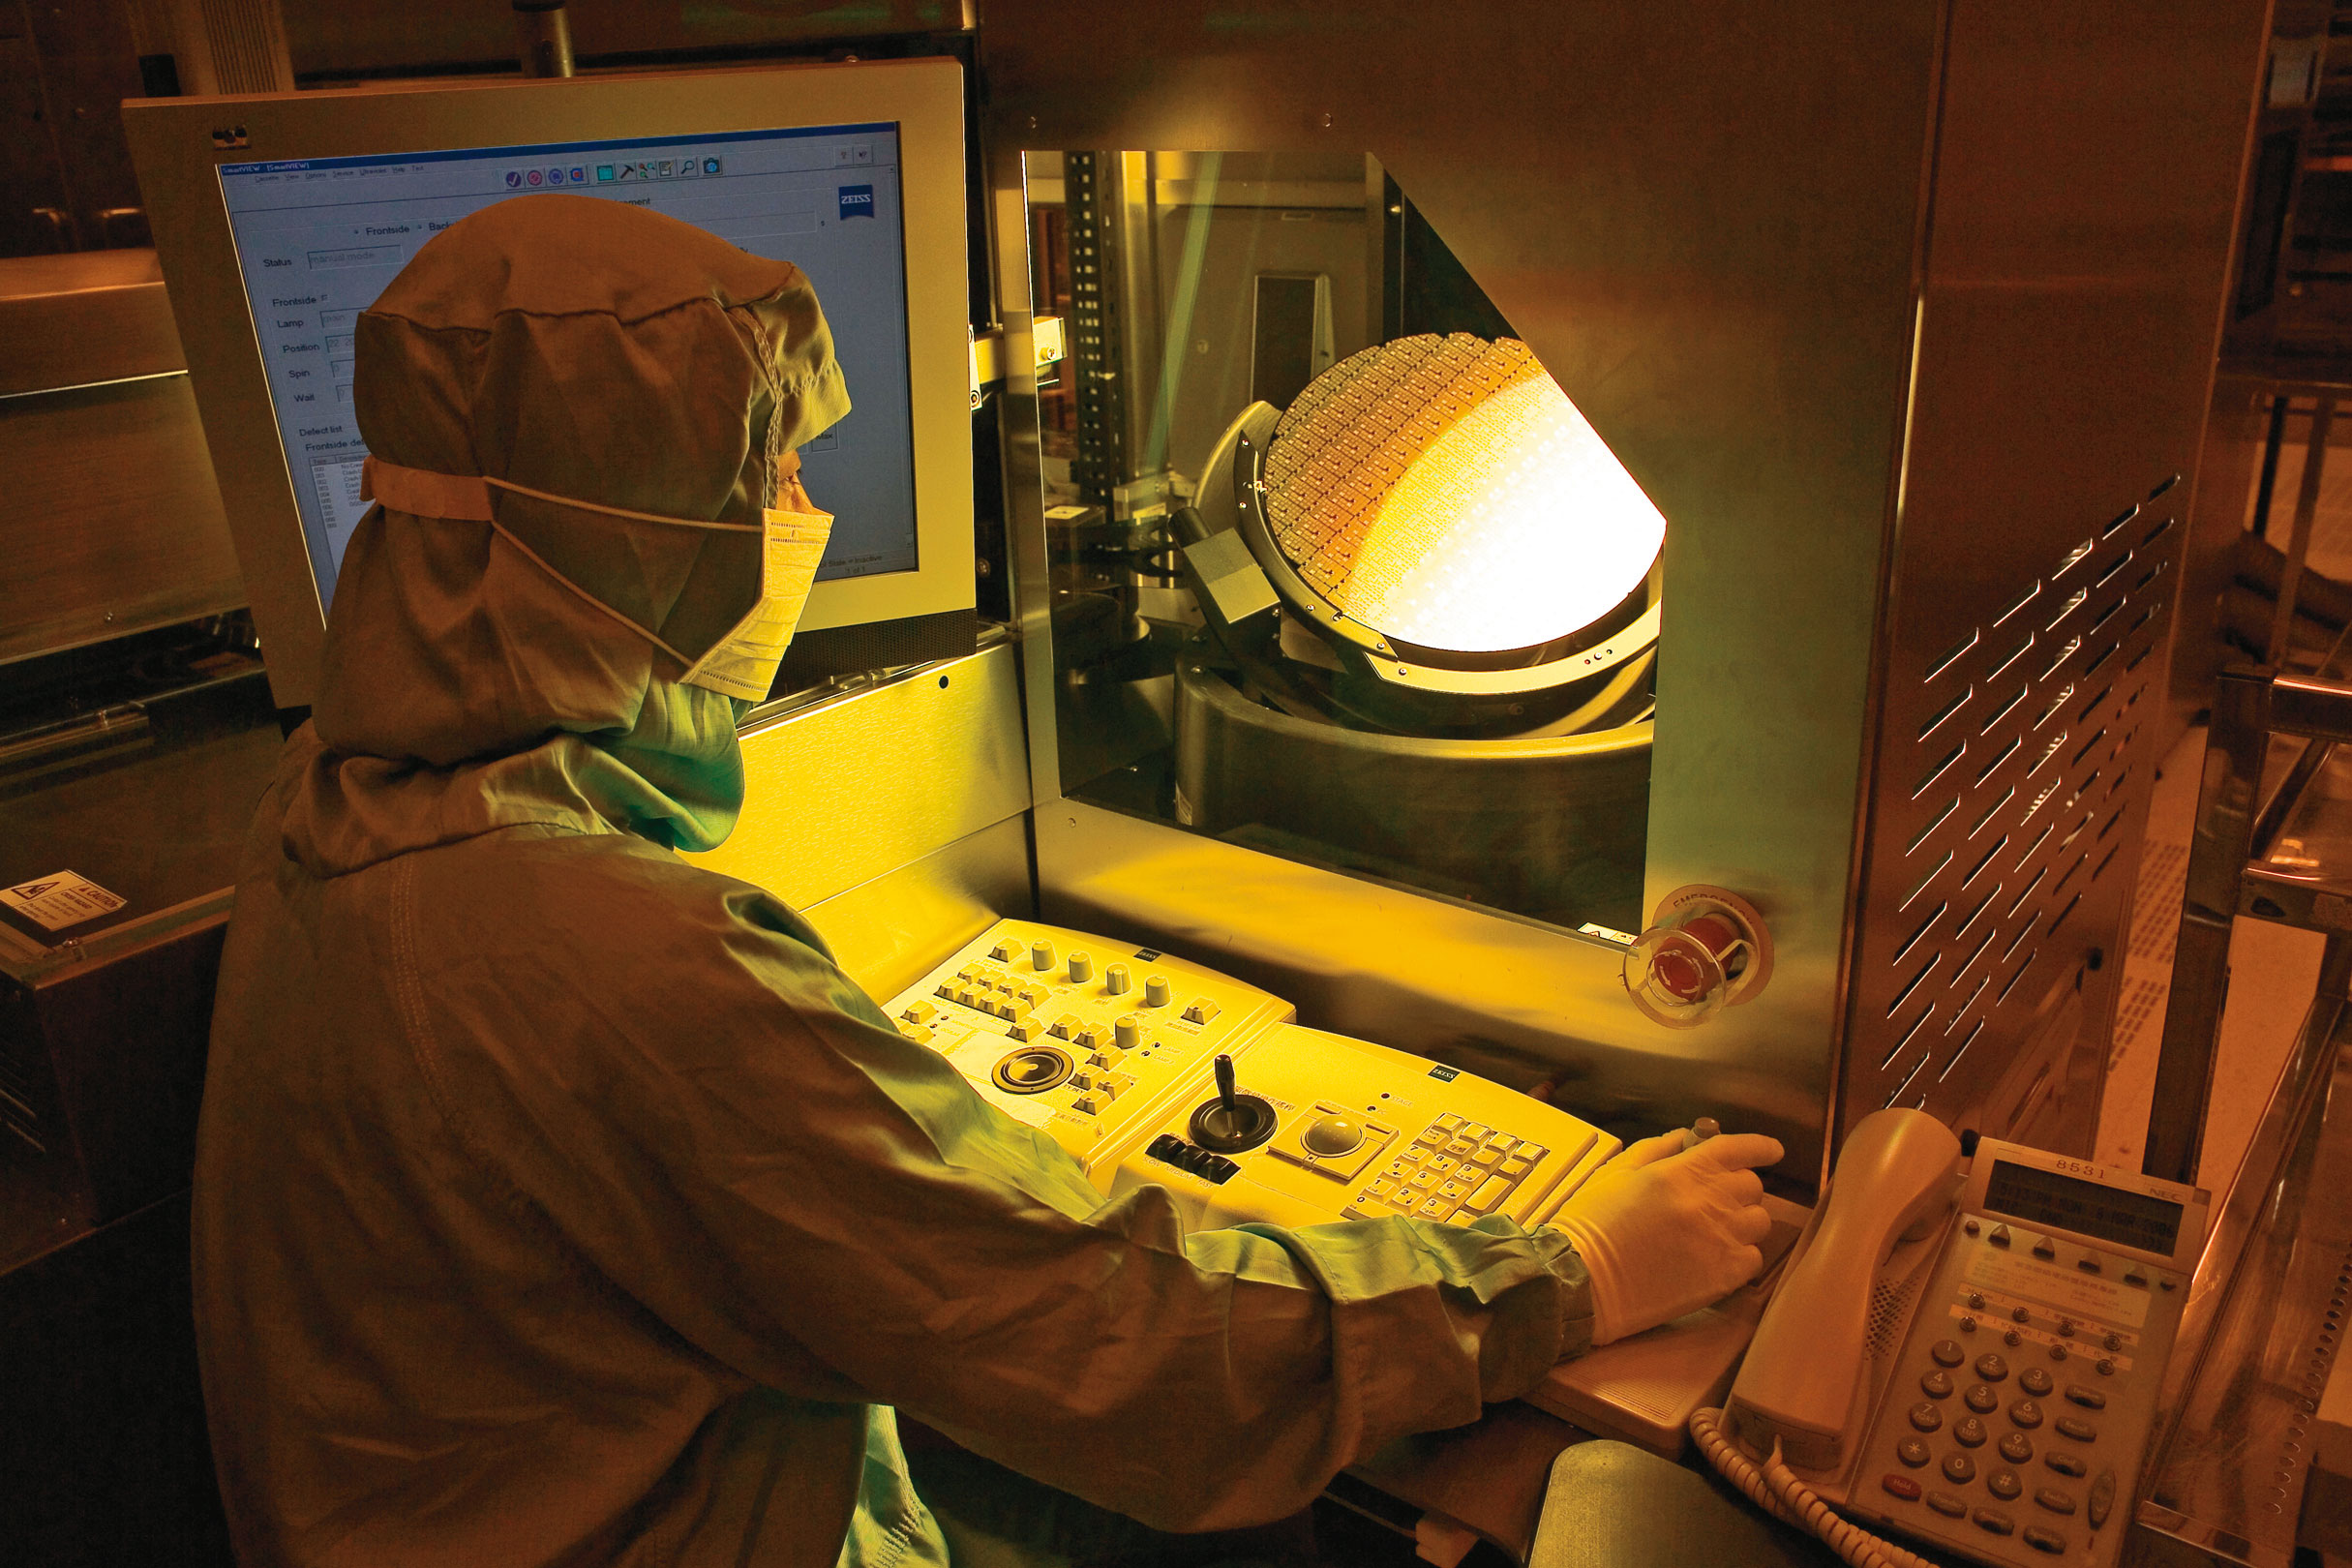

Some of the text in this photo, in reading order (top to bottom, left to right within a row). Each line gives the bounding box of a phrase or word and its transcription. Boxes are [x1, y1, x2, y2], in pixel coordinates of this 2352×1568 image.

[841, 194, 872, 204] ZEISS
[366, 225, 410, 236] Frontside
[262, 256, 293, 268] Status
[272, 295, 317, 308] Frontside
[277, 319, 305, 331] Lamp
[283, 343, 321, 354] Position
[288, 369, 311, 380] Spin
[293, 393, 317, 404] Wait
[298, 425, 344, 437] Defect list
[305, 439, 348, 452] Frontside
[86, 890, 118, 908] CAUTION
[1432, 1068, 1456, 1079] ZEISS
[1391, 1096, 1413, 1107] STAGE
[1142, 1156, 1215, 1190] SLOW MEDIUM FAST
[2055, 1159, 2106, 1180] 8531
[2149, 1187, 2185, 1202] NEC
[1946, 1342, 1953, 1352] 1
[1988, 1355, 1998, 1366] 2
[1934, 1372, 1944, 1382] 4
[2033, 1370, 2043, 1380] 3
[1977, 1386, 1987, 1397] 5
[1923, 1402, 1934, 1413] 7
[2022, 1402, 2033, 1412] 6
[1967, 1418, 1977, 1430] 8
[2013, 1433, 2023, 1444] 9
[1953, 1458, 1965, 1469] 0
[2057, 1454, 2077, 1464] Conf
[1893, 1478, 1912, 1491] Hold
[1998, 1473, 2013, 1487] #
